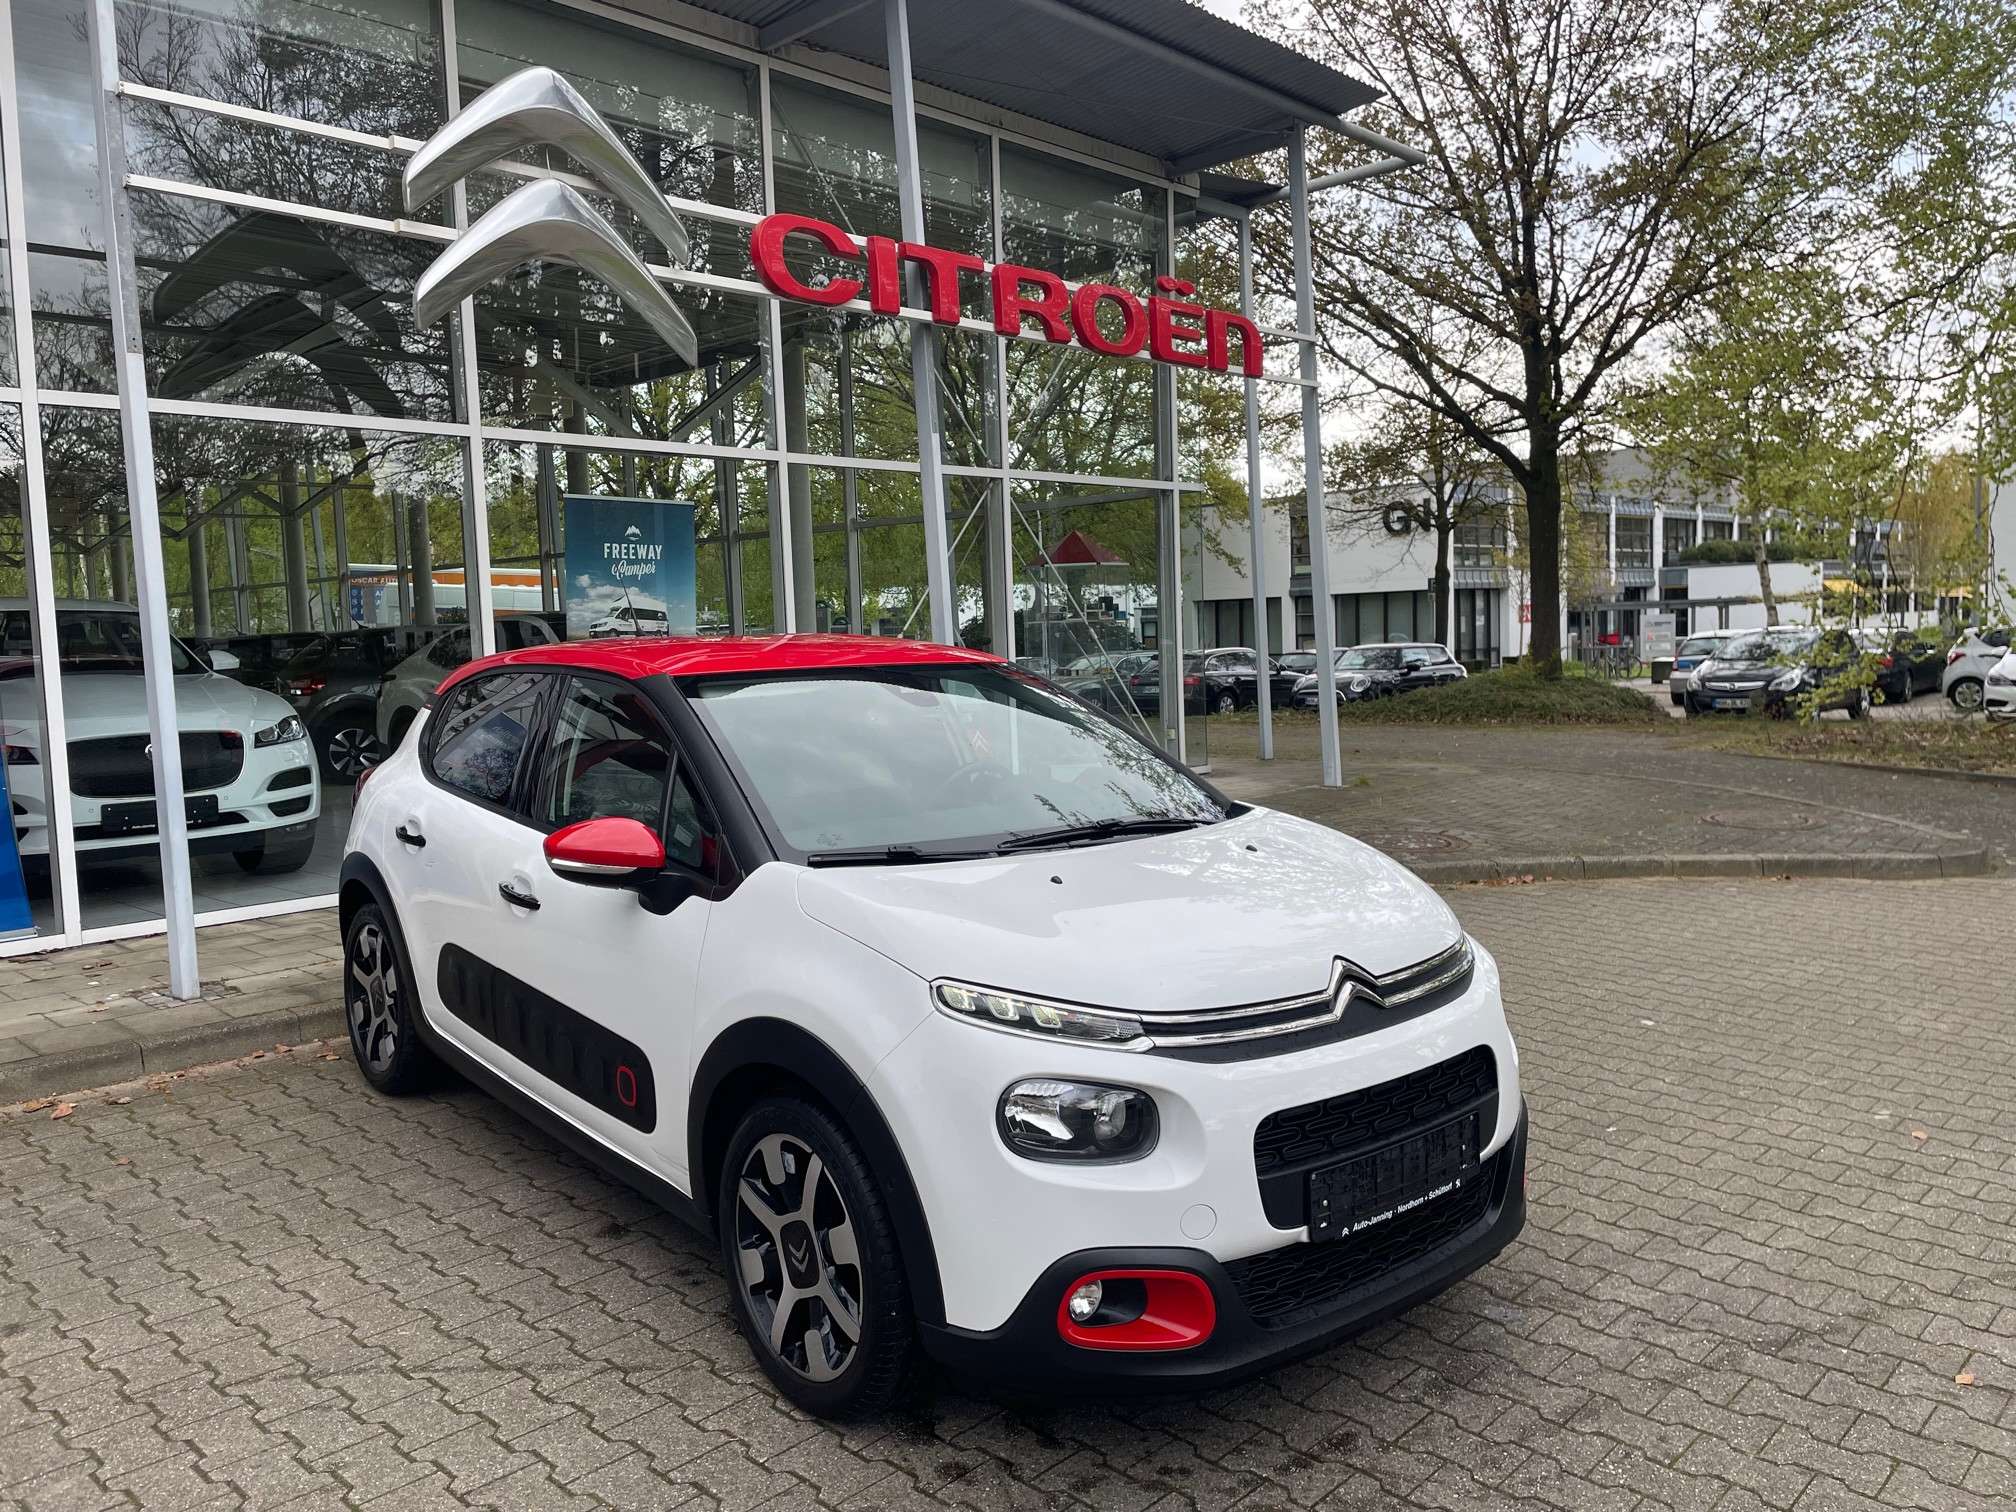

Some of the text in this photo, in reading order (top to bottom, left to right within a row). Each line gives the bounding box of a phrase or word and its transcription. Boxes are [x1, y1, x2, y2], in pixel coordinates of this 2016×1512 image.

[603, 543, 663, 560] FREEWAY
[611, 560, 656, 580] Camper
[1353, 1210, 1393, 1231] Auto-Janning
[1397, 1197, 1424, 1213] Nordhorn
